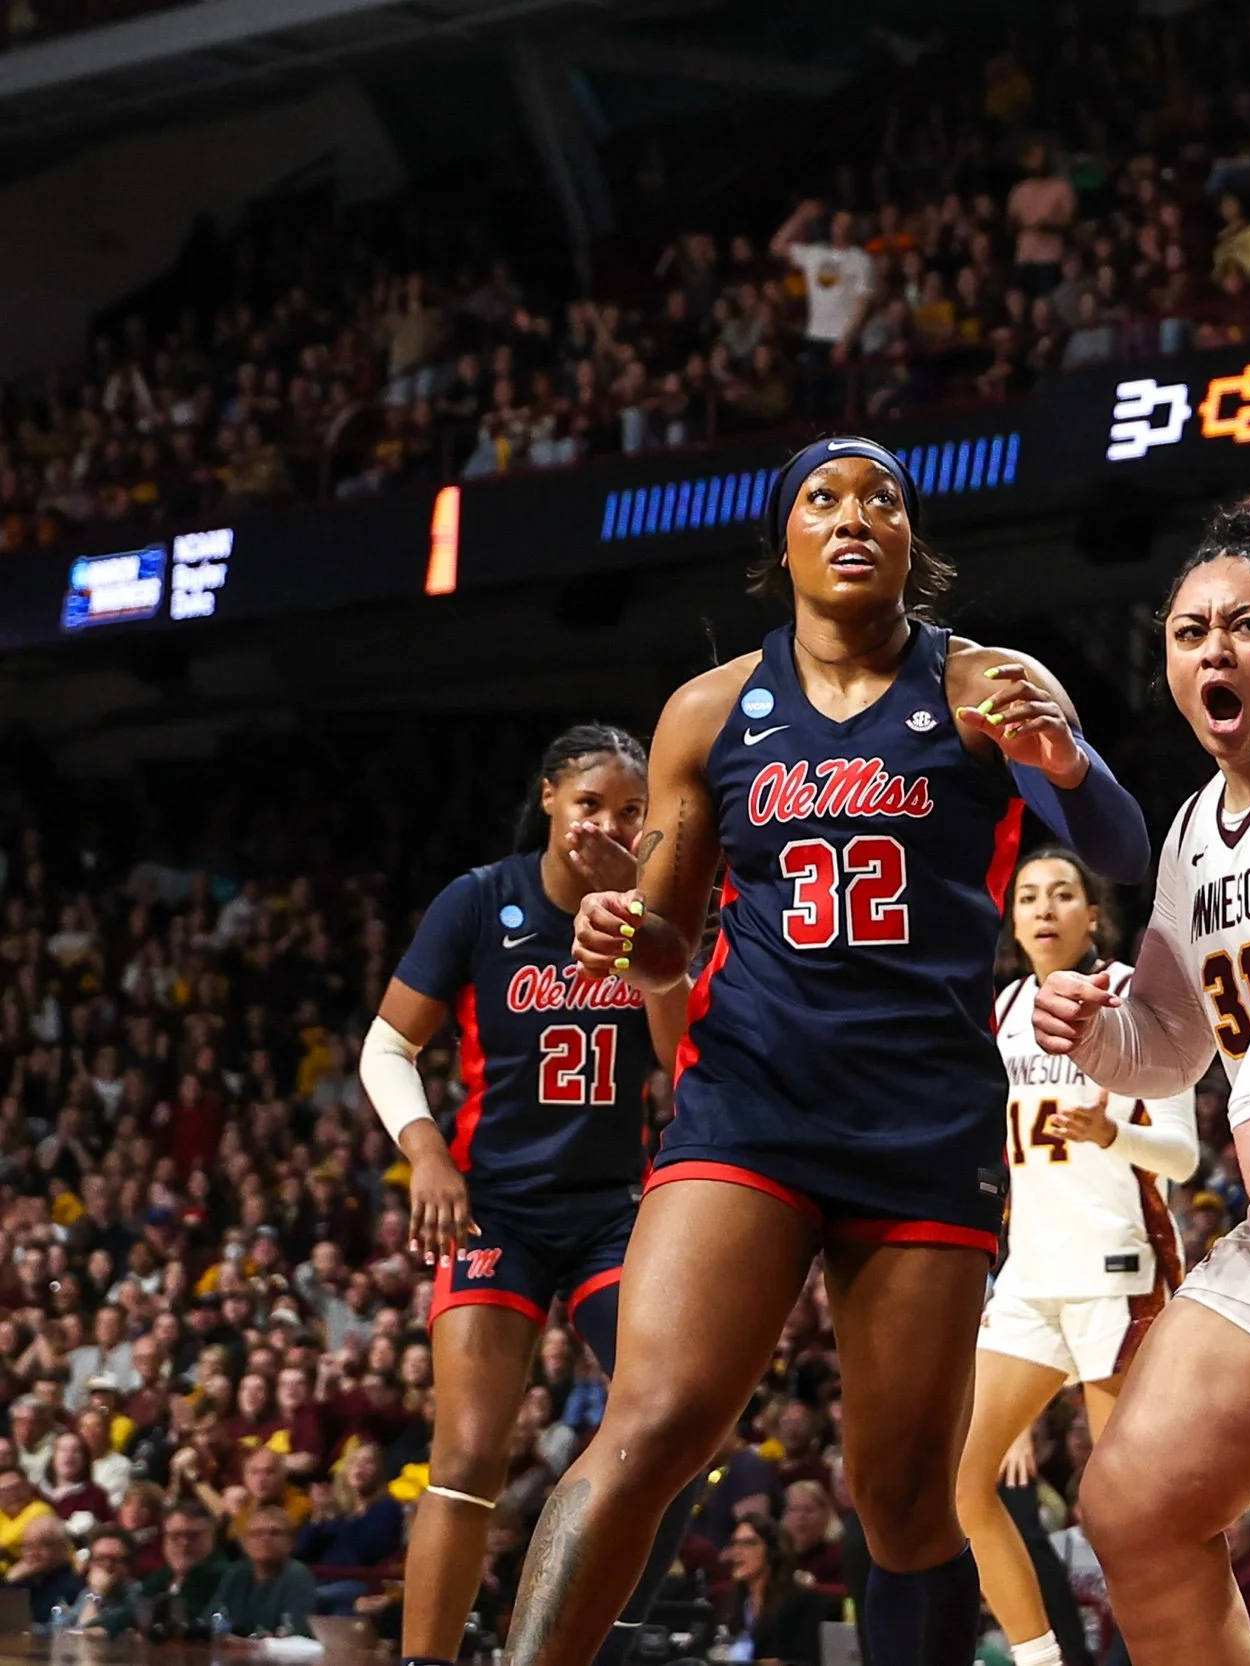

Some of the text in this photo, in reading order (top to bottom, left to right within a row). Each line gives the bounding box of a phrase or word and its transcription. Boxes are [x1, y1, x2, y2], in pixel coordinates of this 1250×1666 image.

[748, 757, 934, 826] Ole Miss
[779, 835, 909, 949] 32
[507, 965, 566, 1013] Ole
[539, 1024, 618, 1105] 21
[1008, 1098, 1069, 1165] 14
